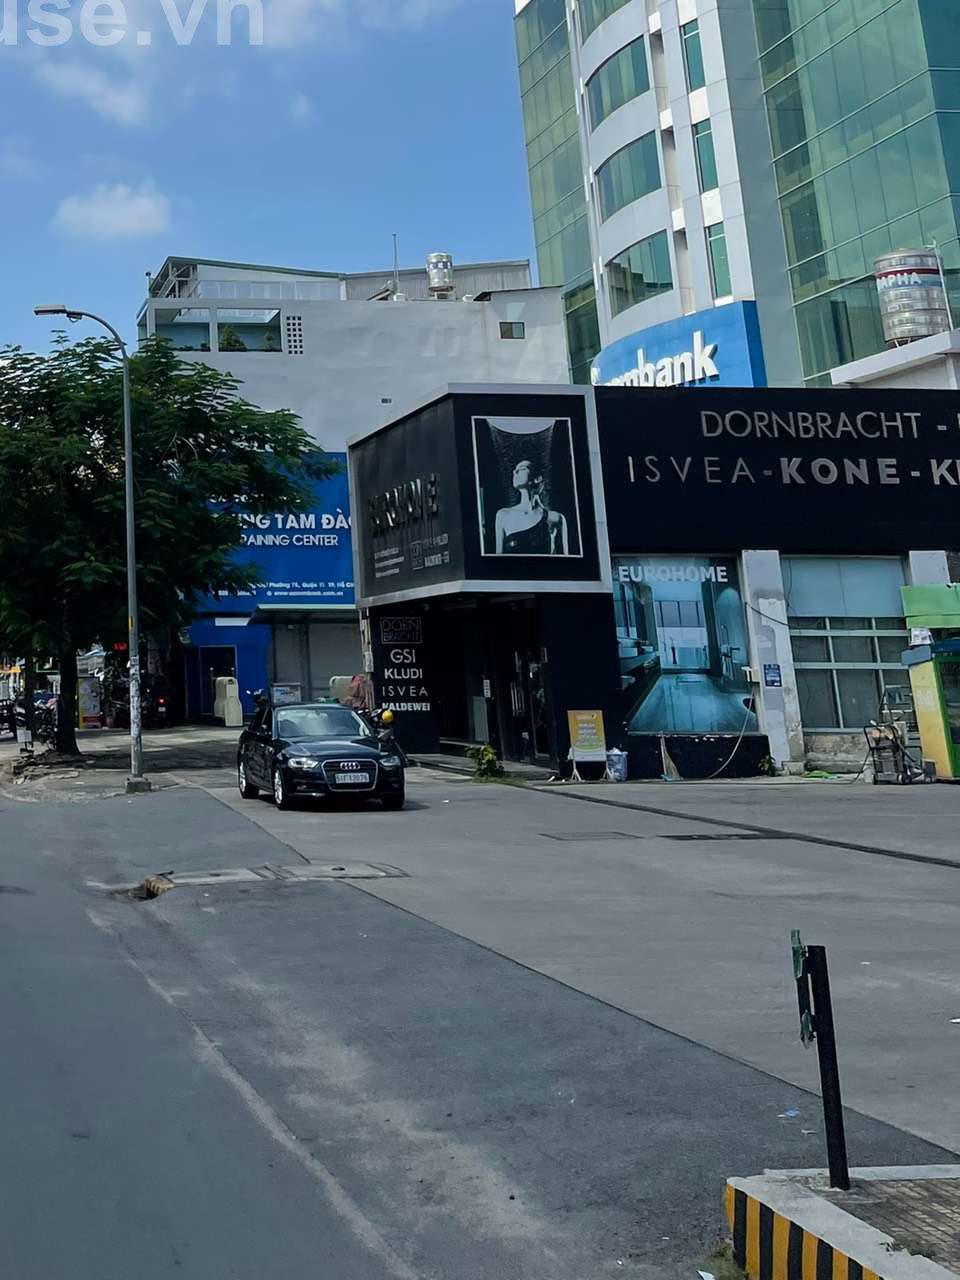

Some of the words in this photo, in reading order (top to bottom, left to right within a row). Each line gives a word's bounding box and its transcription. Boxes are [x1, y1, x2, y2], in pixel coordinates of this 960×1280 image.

[700, 410, 921, 439] DORNBRACHT
[321, 508, 352, 529] ĐÀ
[292, 535, 339, 546] CENTER
[618, 566, 729, 583] EUROHOME
[390, 649, 416, 663] GSI
[384, 668, 423, 679] KLUDI
[382, 686, 428, 696] ISVEA
[382, 702, 431, 711] KALDEWEI
